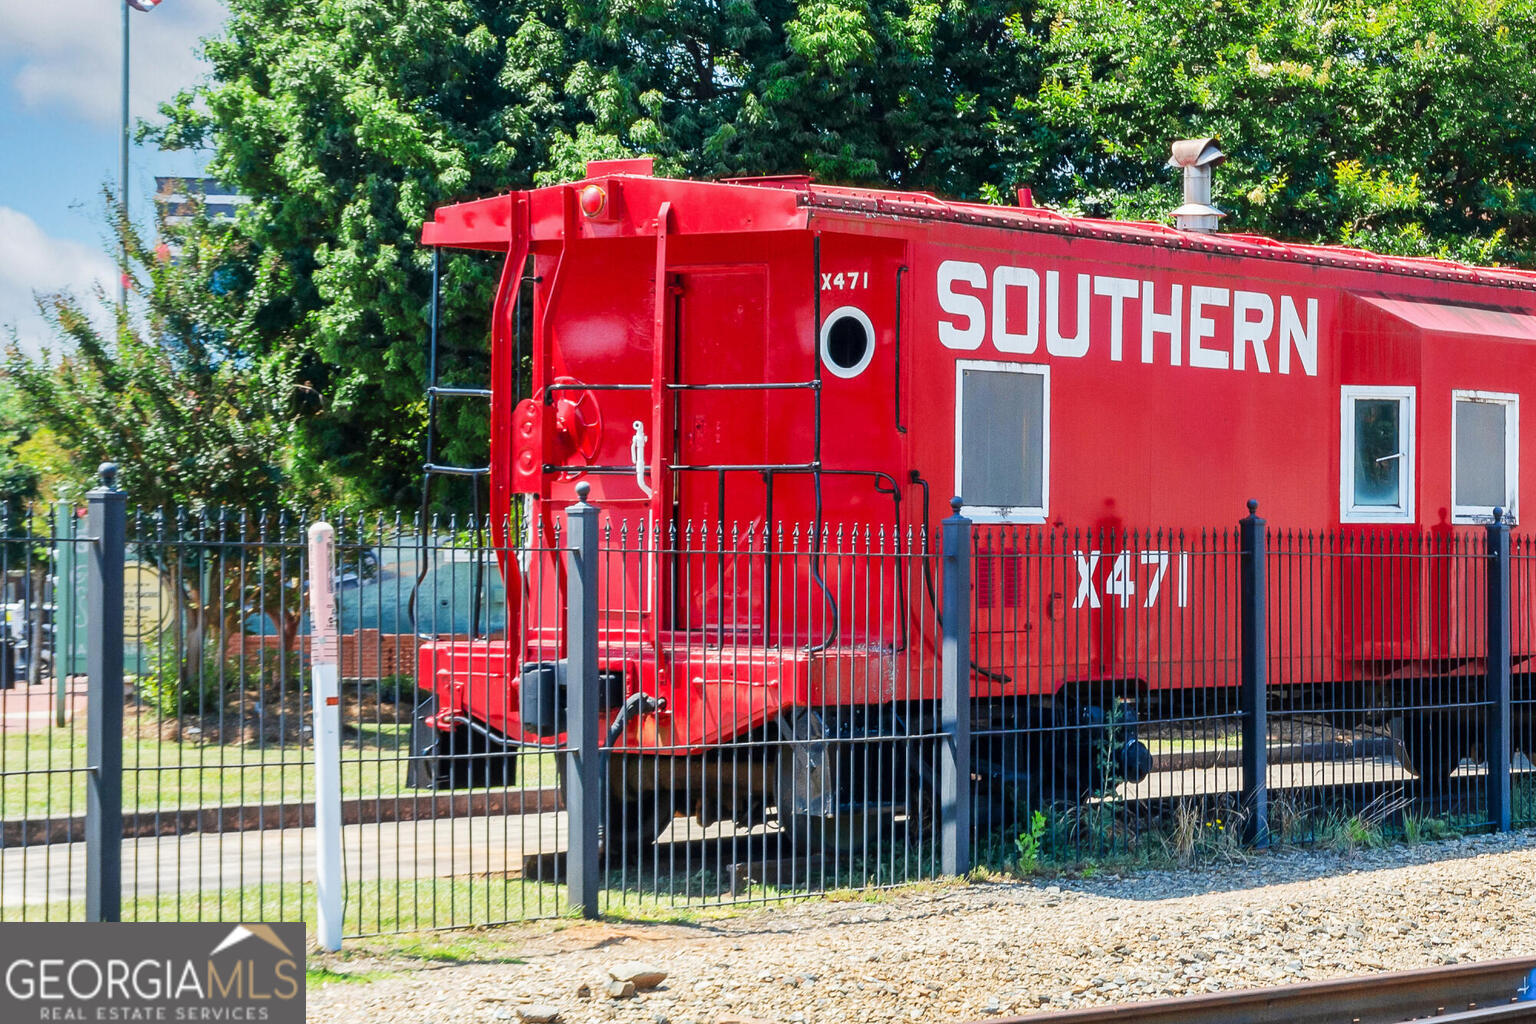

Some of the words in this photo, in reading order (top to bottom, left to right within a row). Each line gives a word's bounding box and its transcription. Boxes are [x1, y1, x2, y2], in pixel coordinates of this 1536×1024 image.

[821, 272, 868, 291] X471
[937, 260, 1318, 376] SOUTHERN
[1072, 550, 1188, 609] X471
